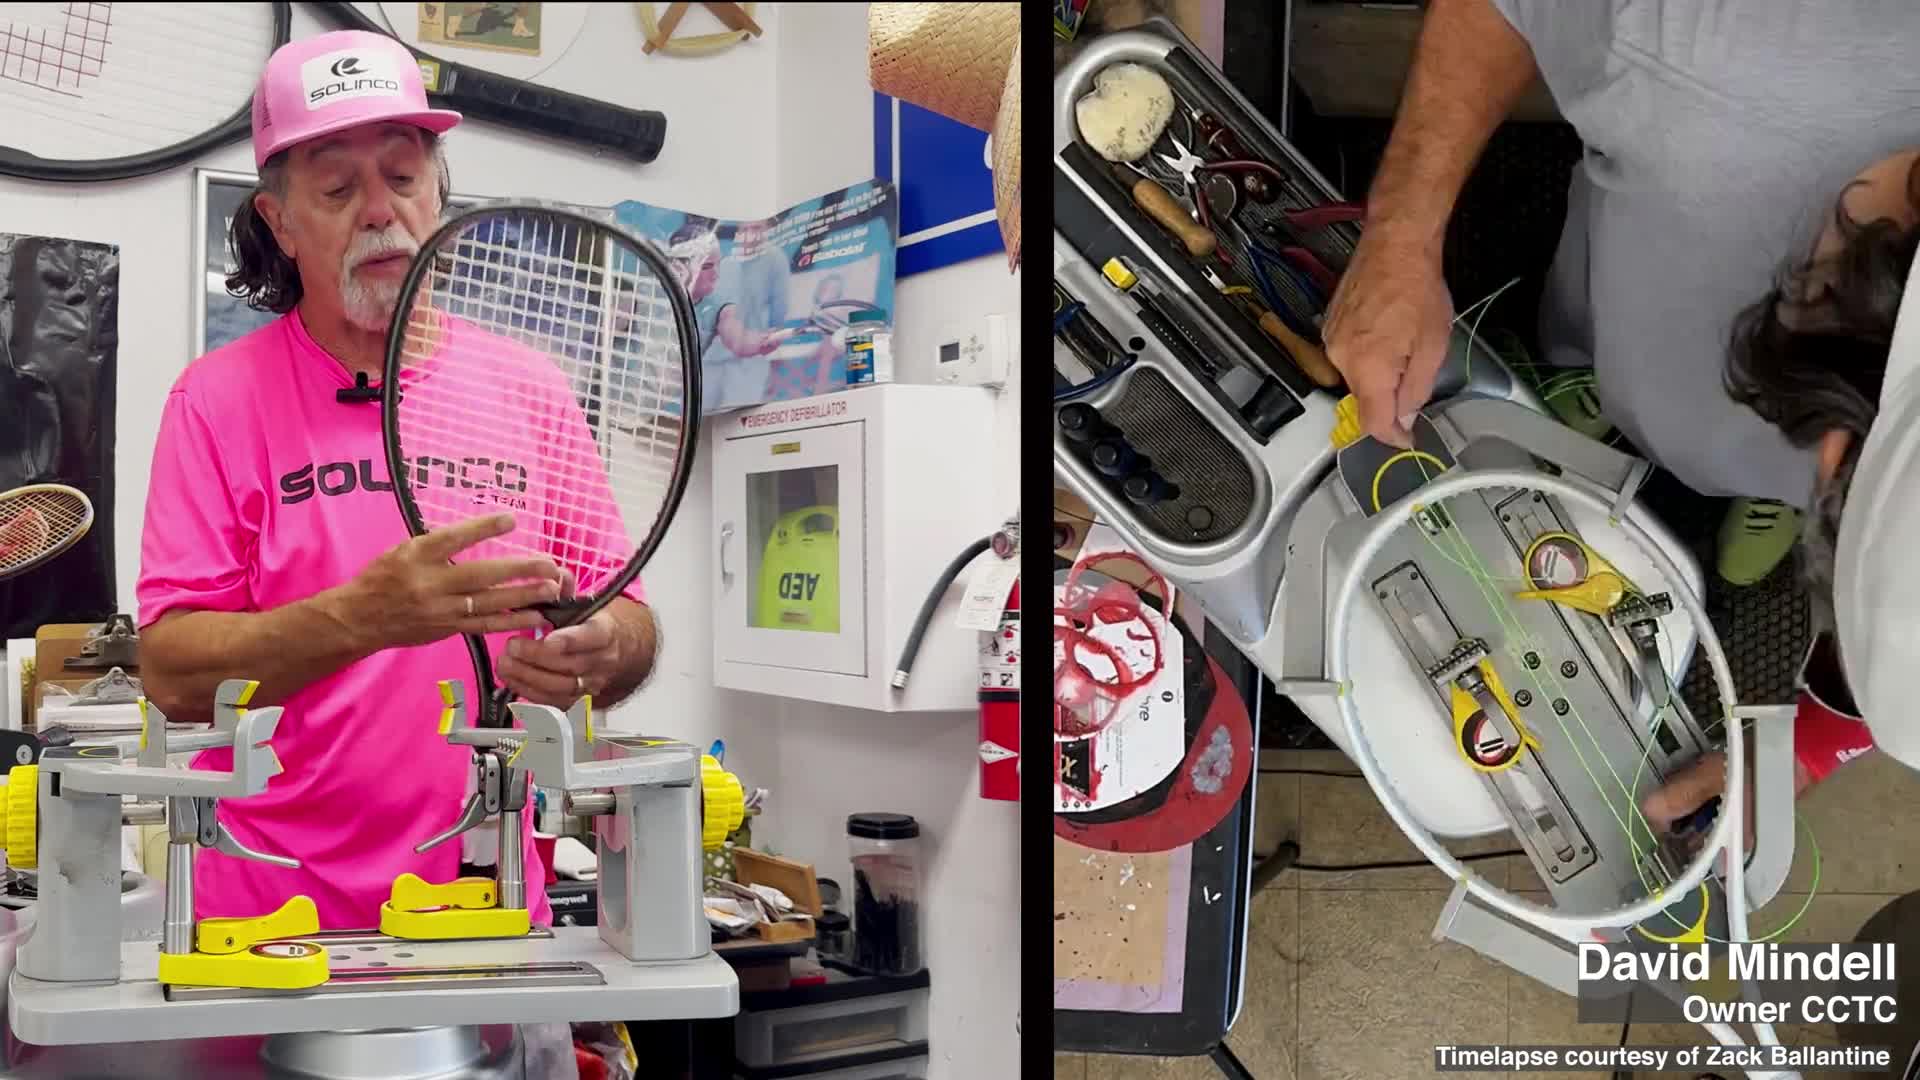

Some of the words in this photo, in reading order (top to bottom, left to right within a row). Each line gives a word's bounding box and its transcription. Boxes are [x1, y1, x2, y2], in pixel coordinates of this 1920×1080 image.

[310, 79, 398, 103] SOLINCO
[748, 409, 790, 428] EMERGENCY
[791, 401, 847, 422] DEFIBRILLATOR
[779, 572, 820, 600] AED
